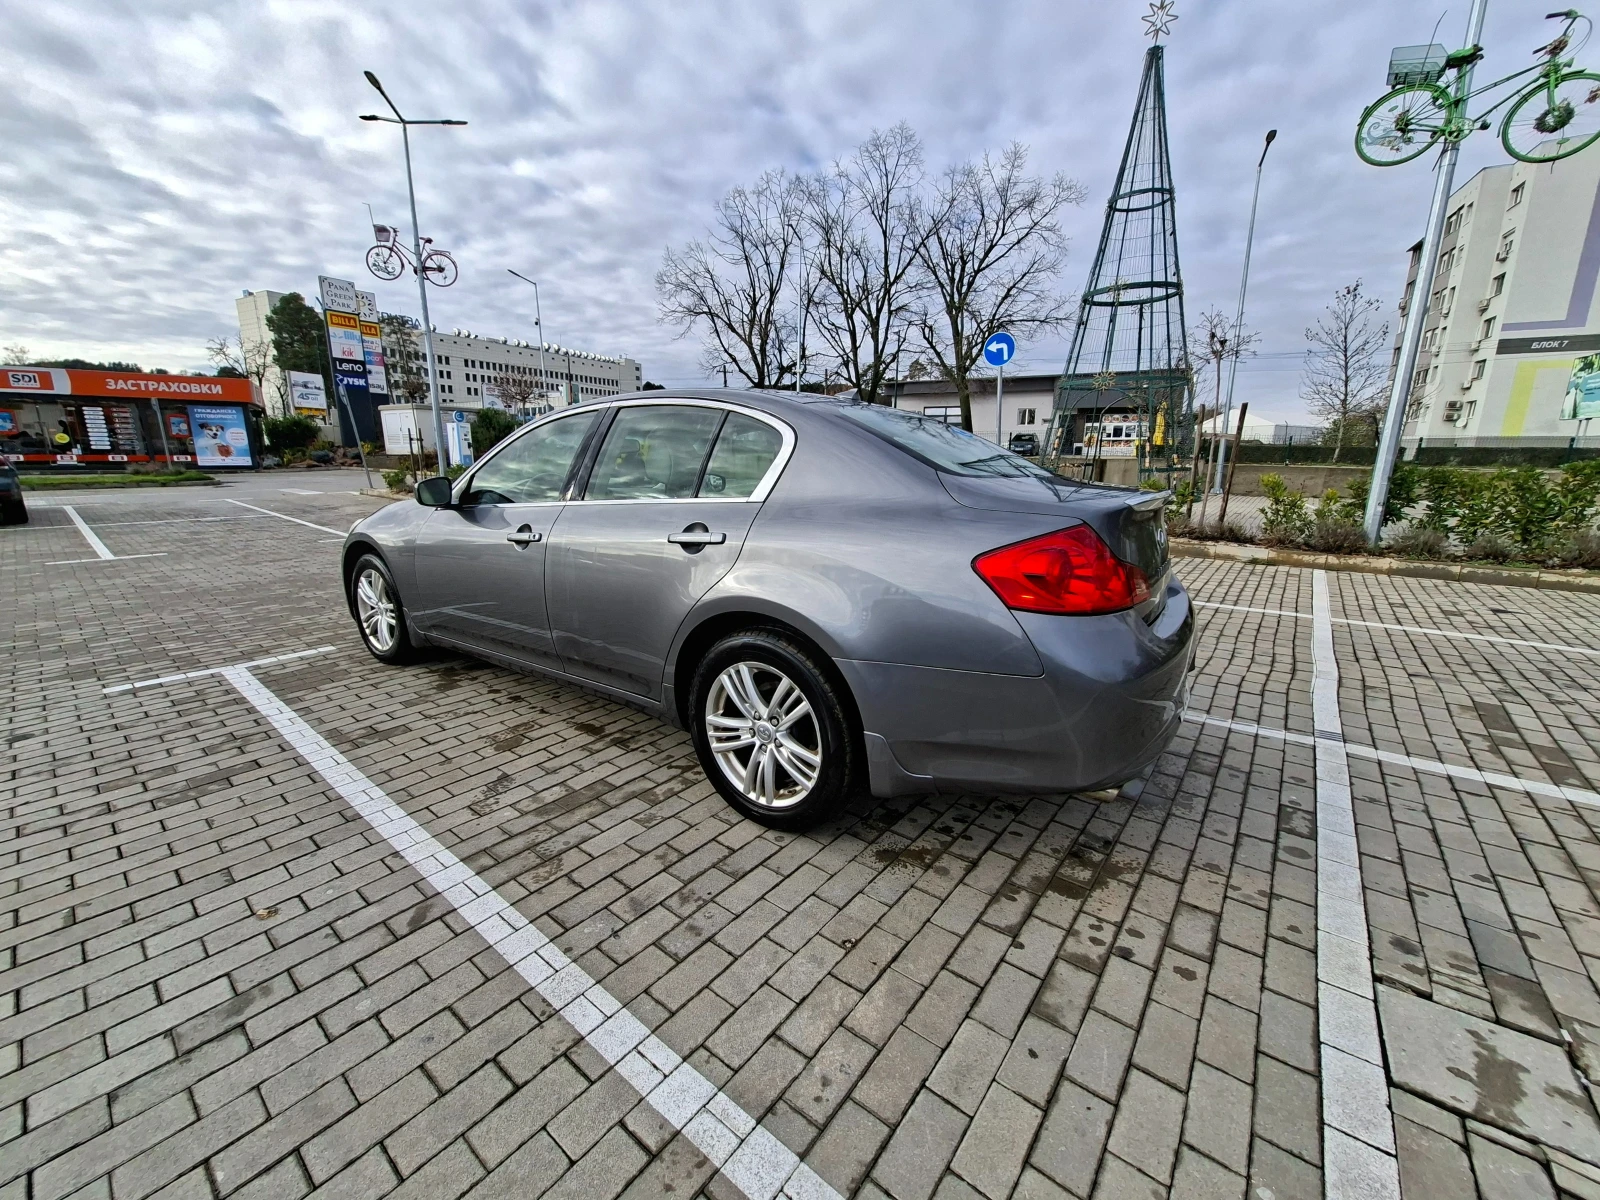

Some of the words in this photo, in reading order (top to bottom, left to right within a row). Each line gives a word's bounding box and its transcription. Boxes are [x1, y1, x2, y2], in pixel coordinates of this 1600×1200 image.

[328, 282, 350, 292] PANA
[326, 290, 354, 301] GREEN
[330, 299, 352, 309] PARK
[331, 315, 356, 326] BILLA
[361, 325, 377, 335] ILLA
[1531, 341, 1561, 349] БЛОК
[1561, 340, 1569, 348] 7
[342, 346, 354, 357] kik
[11, 373, 38, 384] SDI
[343, 377, 367, 386] JYSK
[105, 378, 222, 395] ЗАСТРАХОВКИ
